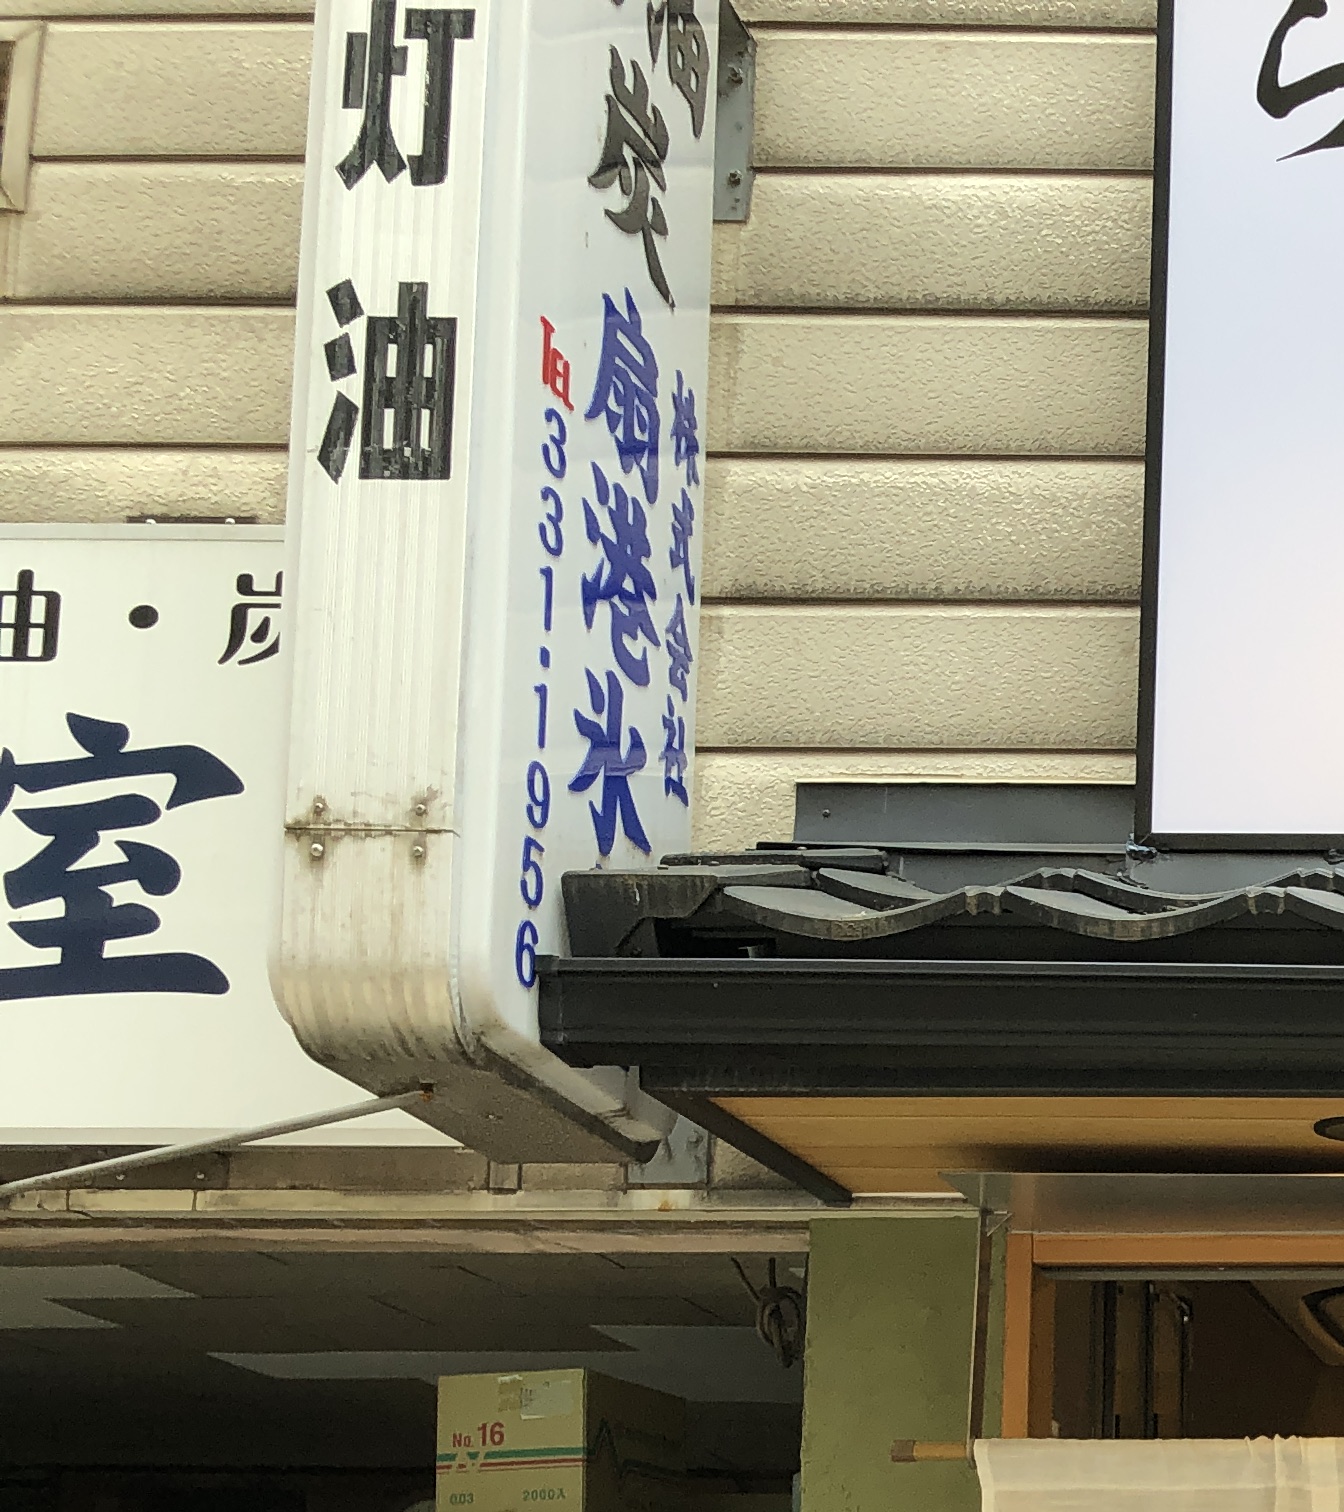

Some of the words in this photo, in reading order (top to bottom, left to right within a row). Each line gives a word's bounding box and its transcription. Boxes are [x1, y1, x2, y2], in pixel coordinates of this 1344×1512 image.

[316, 0, 476, 485] 灯油
[568, 287, 661, 868] 扇港氷
[659, 369, 700, 807] 株式会社
[0, 712, 244, 1000] 室
